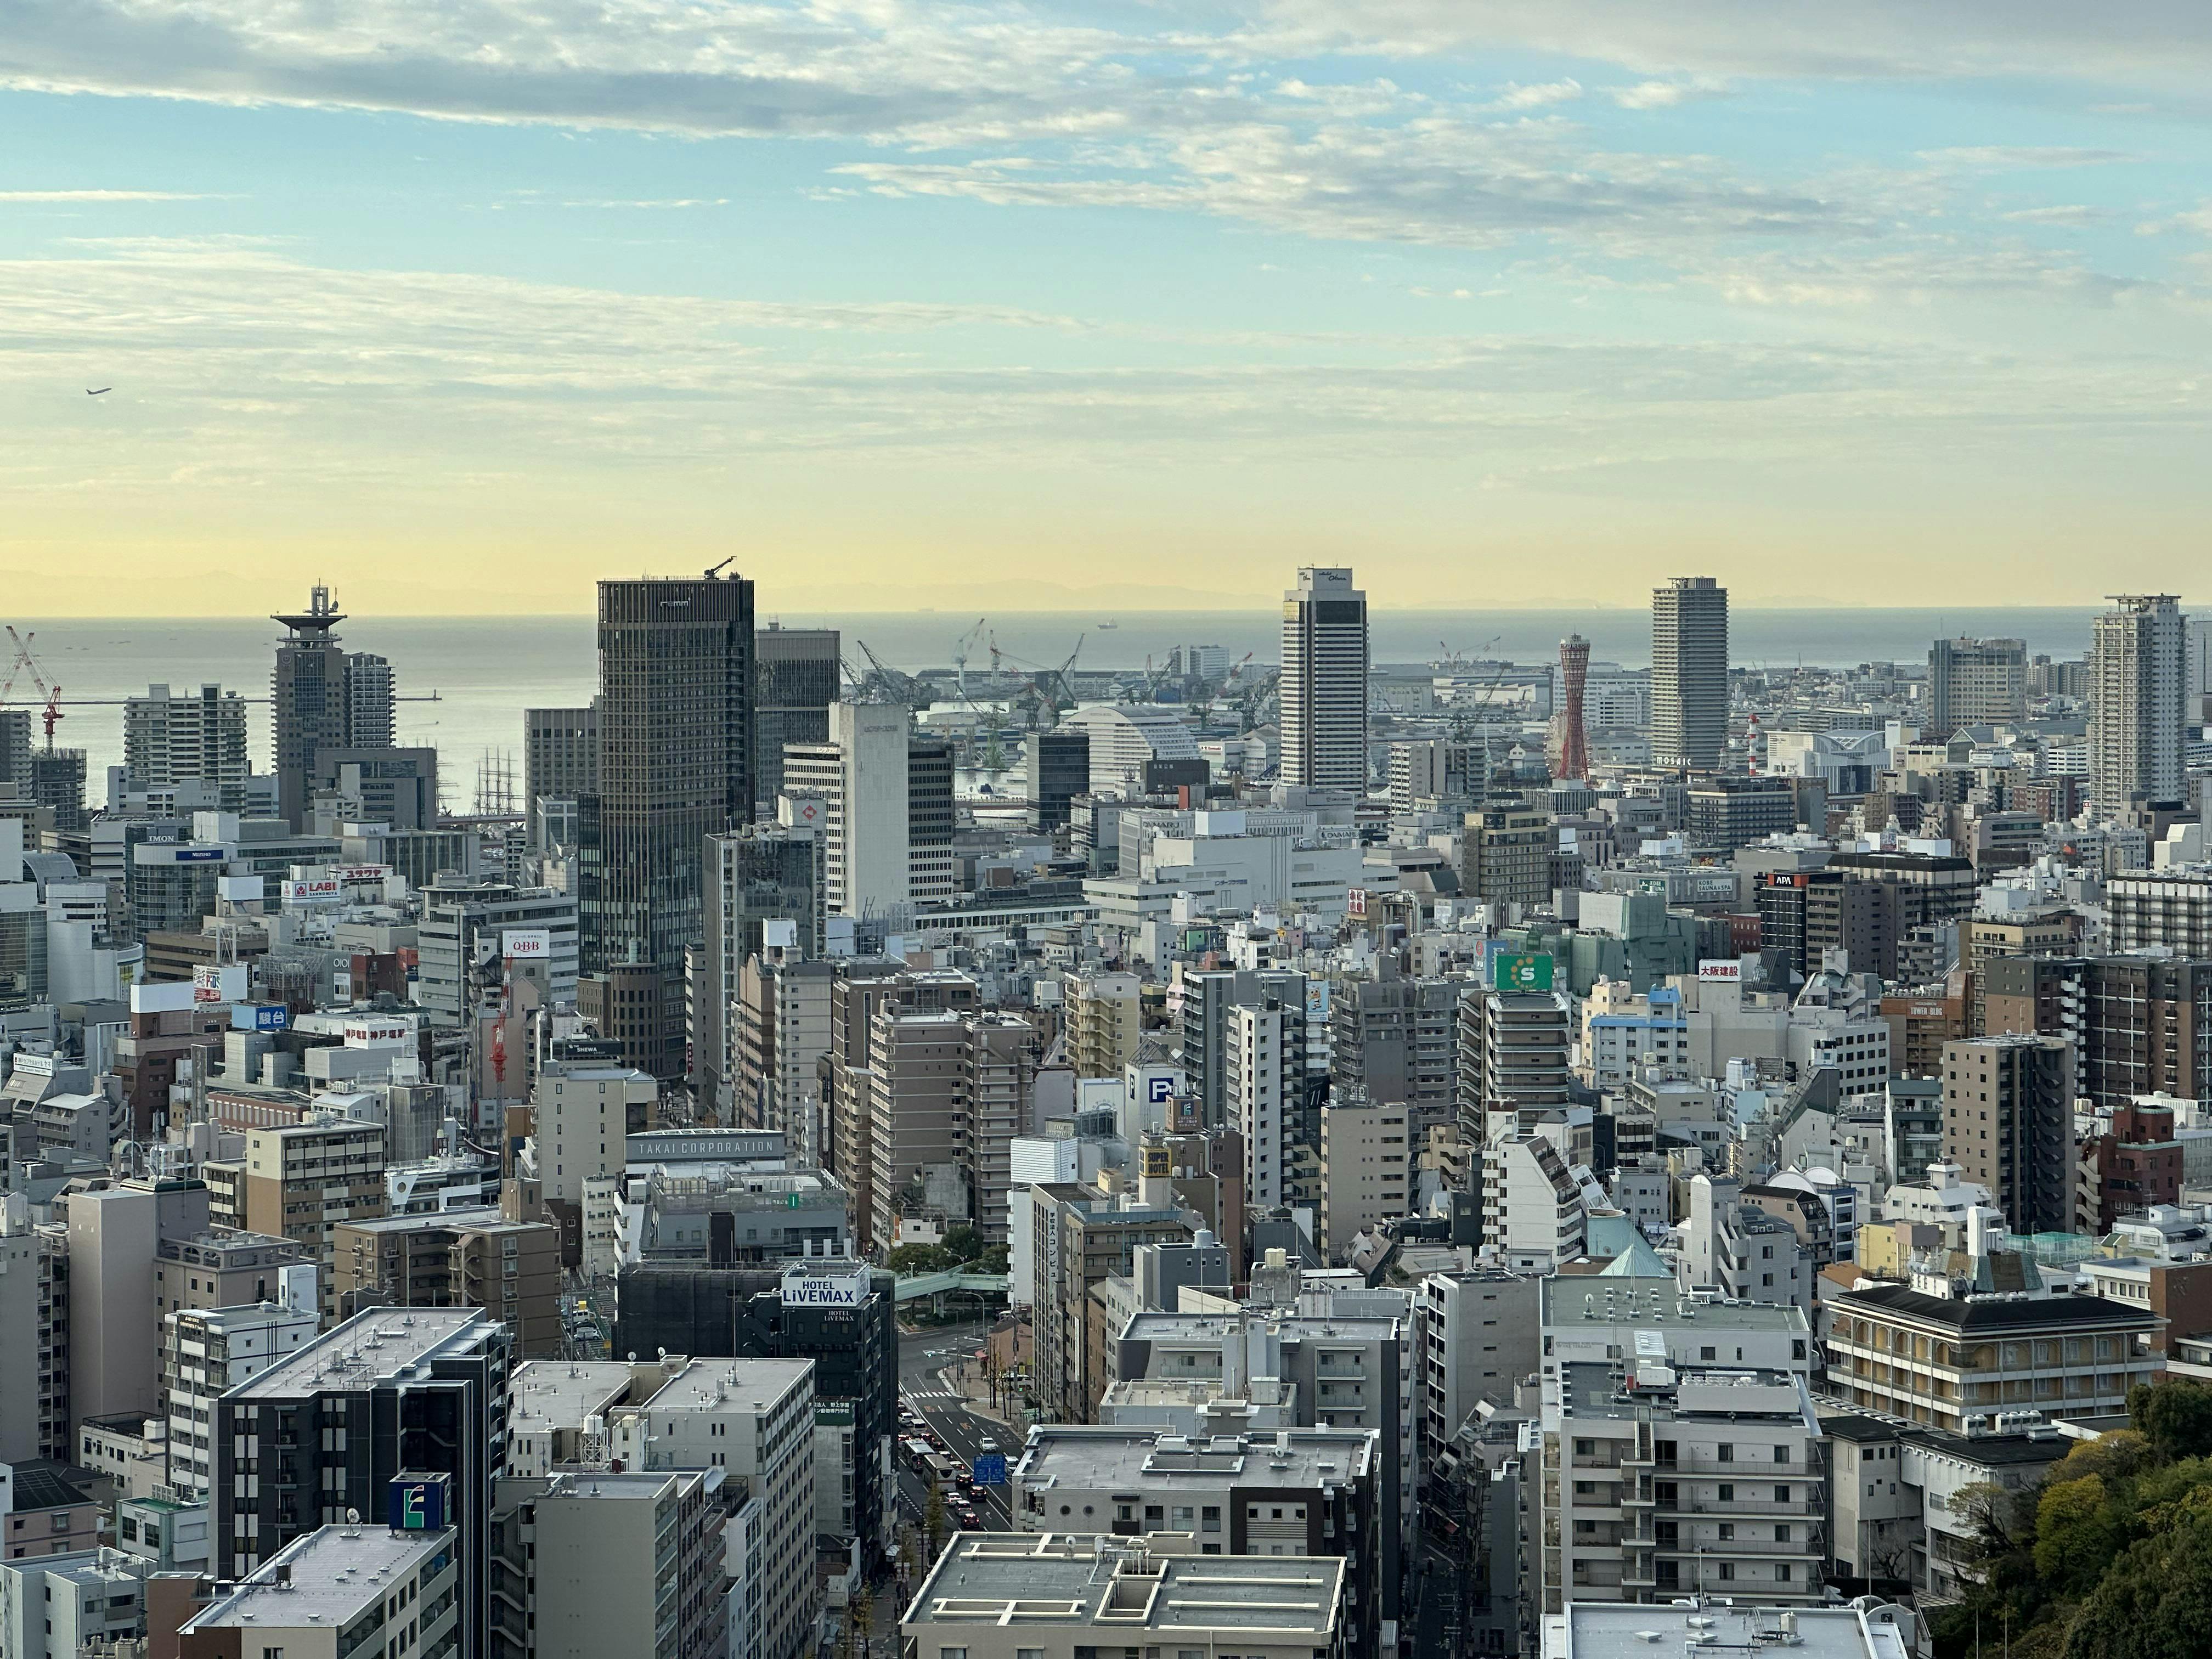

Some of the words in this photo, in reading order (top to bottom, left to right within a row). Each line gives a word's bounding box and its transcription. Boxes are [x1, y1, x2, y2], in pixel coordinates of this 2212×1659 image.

[1656, 757, 1691, 766] MOSAIC
[1776, 876, 1791, 884] APA
[309, 882, 336, 892] LABI
[1701, 966, 1739, 977] 大阪建設
[425, 1089, 433, 1101] P
[1152, 1081, 1170, 1100] P
[639, 1144, 675, 1154] TAKAI
[681, 1141, 773, 1153] CORPORATION
[1148, 1152, 1169, 1163] SUPER
[1148, 1163, 1169, 1175] HOTEL
[803, 1281, 835, 1290] HOTEL
[783, 1290, 854, 1303] LiVEMAX
